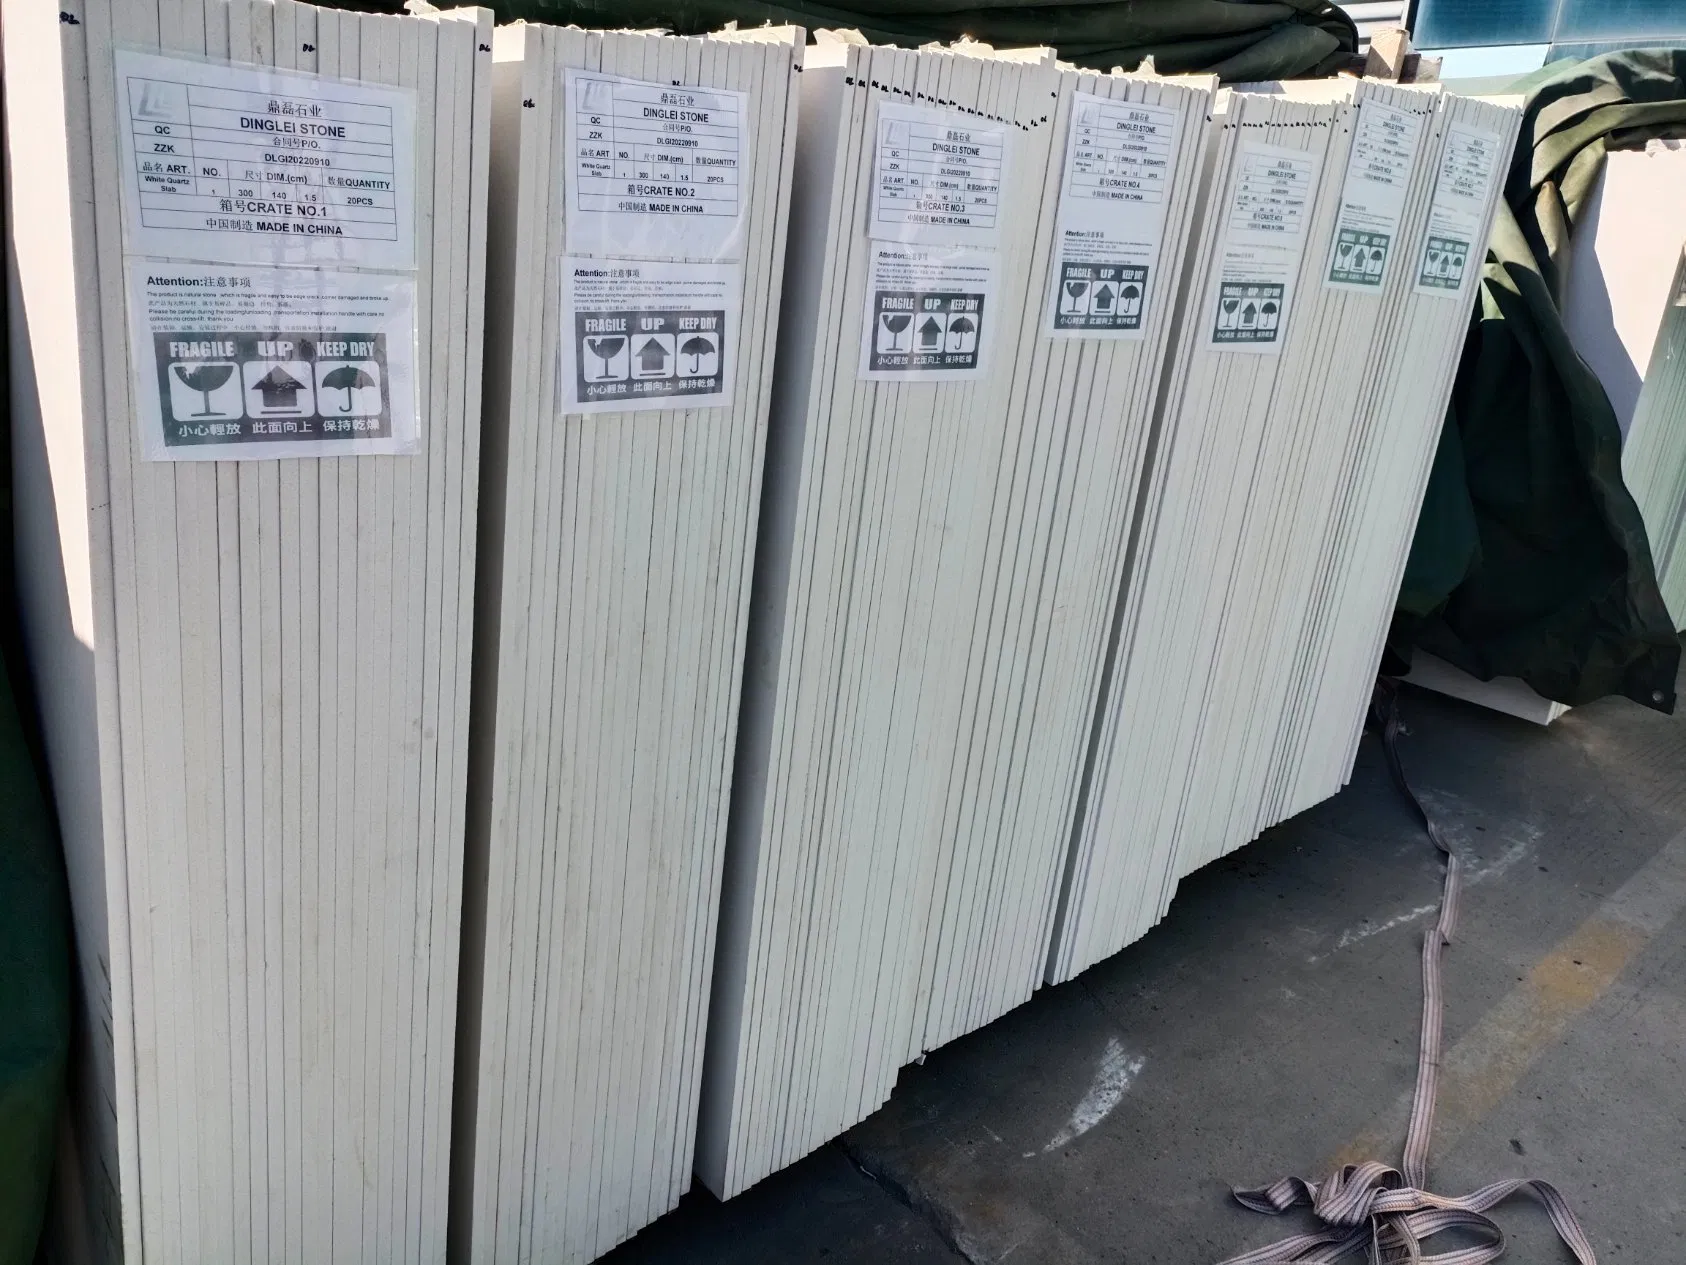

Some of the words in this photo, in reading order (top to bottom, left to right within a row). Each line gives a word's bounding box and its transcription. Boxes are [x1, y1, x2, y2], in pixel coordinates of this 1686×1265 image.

[267, 99, 322, 118] 鼎磊石业
[590, 116, 600, 124] QC
[643, 108, 678, 120] DINGLEI
[680, 111, 709, 123] STONE
[155, 125, 170, 136] QC
[240, 117, 296, 133] DINGLEI
[300, 122, 345, 138] STONE
[1139, 124, 1156, 134] STONE
[154, 143, 175, 153] ZZK
[932, 142, 958, 153] DINGLEI
[959, 146, 980, 156] STONE
[142, 161, 163, 173] 品名
[166, 164, 191, 174] ART.
[202, 167, 221, 177] NO.
[145, 175, 165, 184] White
[166, 177, 190, 186] Quartz
[160, 185, 177, 193] Slab
[238, 189, 253, 198] 300
[628, 184, 673, 196] 箱号CRATE
[675, 188, 695, 197] NO.2
[272, 191, 287, 200] 140
[304, 193, 317, 202] 1.5
[347, 196, 373, 206] 20PCS
[219, 198, 292, 215] 箱号CRATE
[297, 204, 327, 217] NO.1
[649, 203, 671, 212] MADE
[672, 204, 680, 212] IN
[681, 204, 704, 213] CHINA
[930, 216, 946, 224] MADE
[954, 217, 970, 225] CHINA
[206, 218, 253, 231] 中国制造
[256, 221, 290, 232] MADE
[292, 223, 304, 233] IN
[307, 224, 343, 235] CHINA
[574, 268, 640, 278] Attention:注意事项
[1066, 268, 1092, 278] FRAGILE
[1100, 269, 1115, 279] UP
[147, 275, 251, 289] Attention:注意事项
[1248, 287, 1259, 296] UP
[882, 297, 914, 310] FRAGILE
[924, 298, 942, 310] UP
[950, 299, 965, 310] KEEP
[966, 299, 979, 310] DRY
[585, 318, 627, 332] FRAGILE
[640, 317, 665, 330] UP
[679, 317, 700, 330] KEEP
[700, 316, 717, 330] DRY
[169, 340, 235, 358] FRAGILE
[257, 340, 294, 357] UP
[316, 340, 348, 357] KEEP
[350, 340, 375, 357] DRY
[633, 381, 672, 392] 此面向上
[252, 421, 312, 434] 此面向上
[323, 420, 380, 432] 保持乾燥
